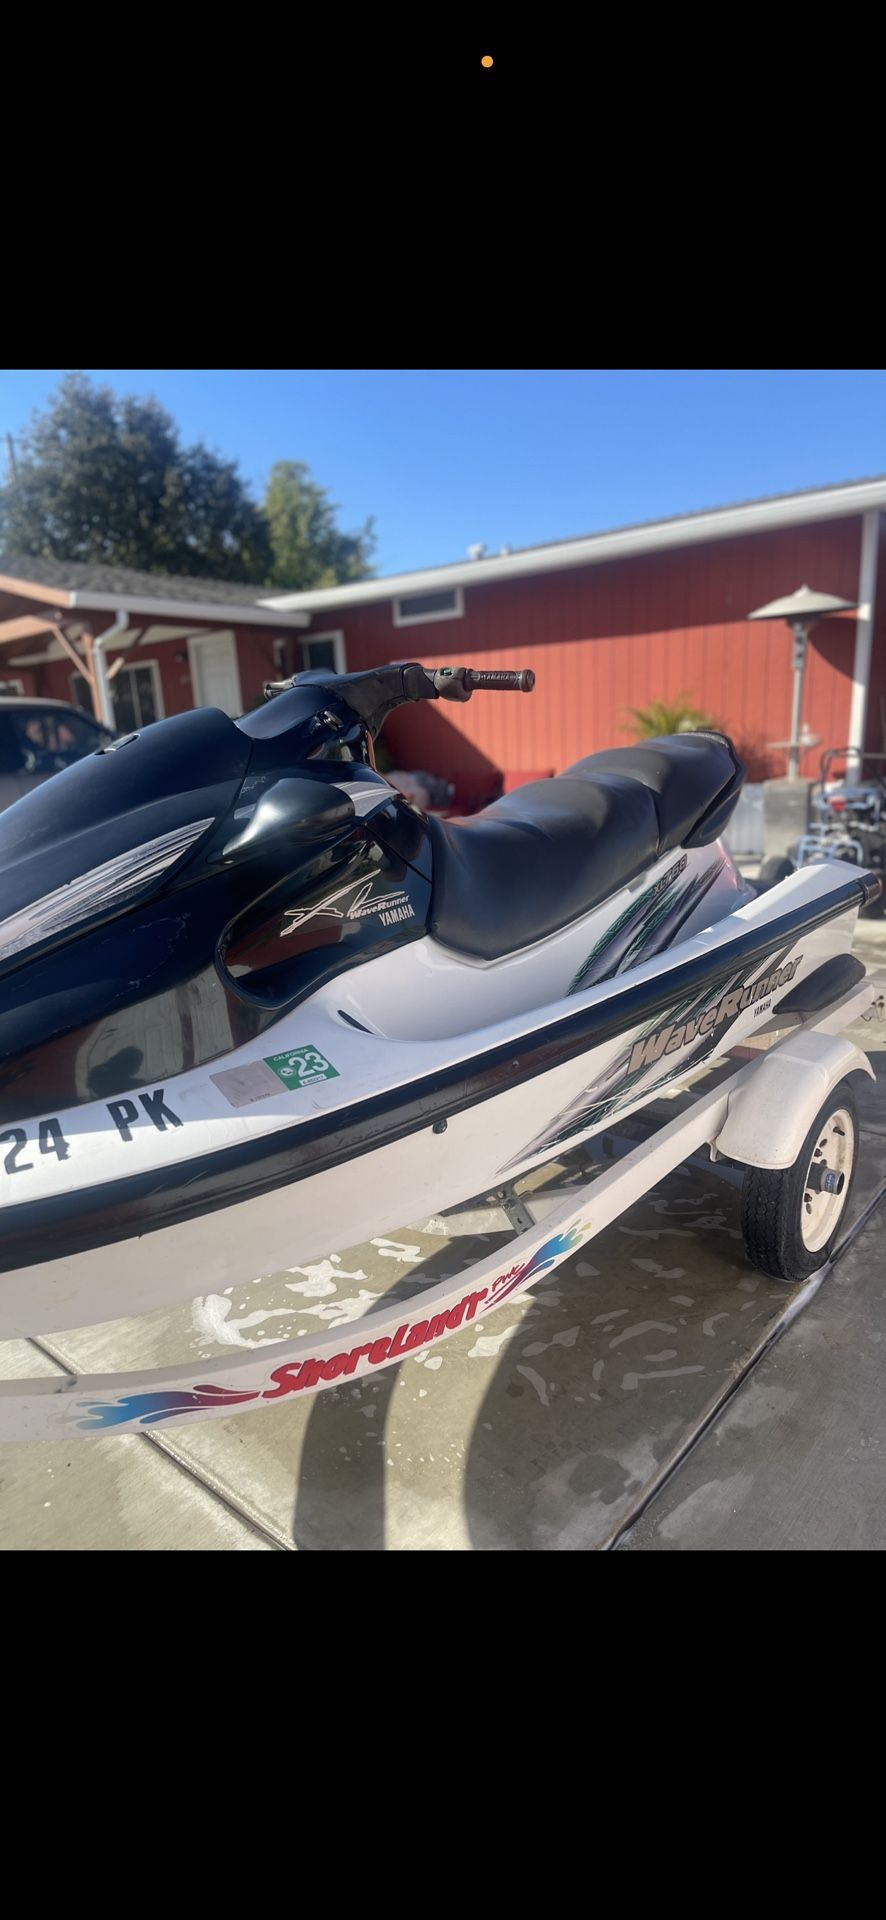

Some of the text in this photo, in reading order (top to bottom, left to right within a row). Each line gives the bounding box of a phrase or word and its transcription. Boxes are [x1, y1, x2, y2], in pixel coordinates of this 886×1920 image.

[482, 672, 510, 681] YAMAHA
[347, 895, 410, 920] WaveRunner
[379, 904, 415, 926] YAMAHA
[627, 955, 803, 1075] WaveRunner
[273, 1048, 309, 1062] CALIFORNIA
[288, 1052, 329, 1078] 23
[0, 1089, 184, 1174] 24 PK
